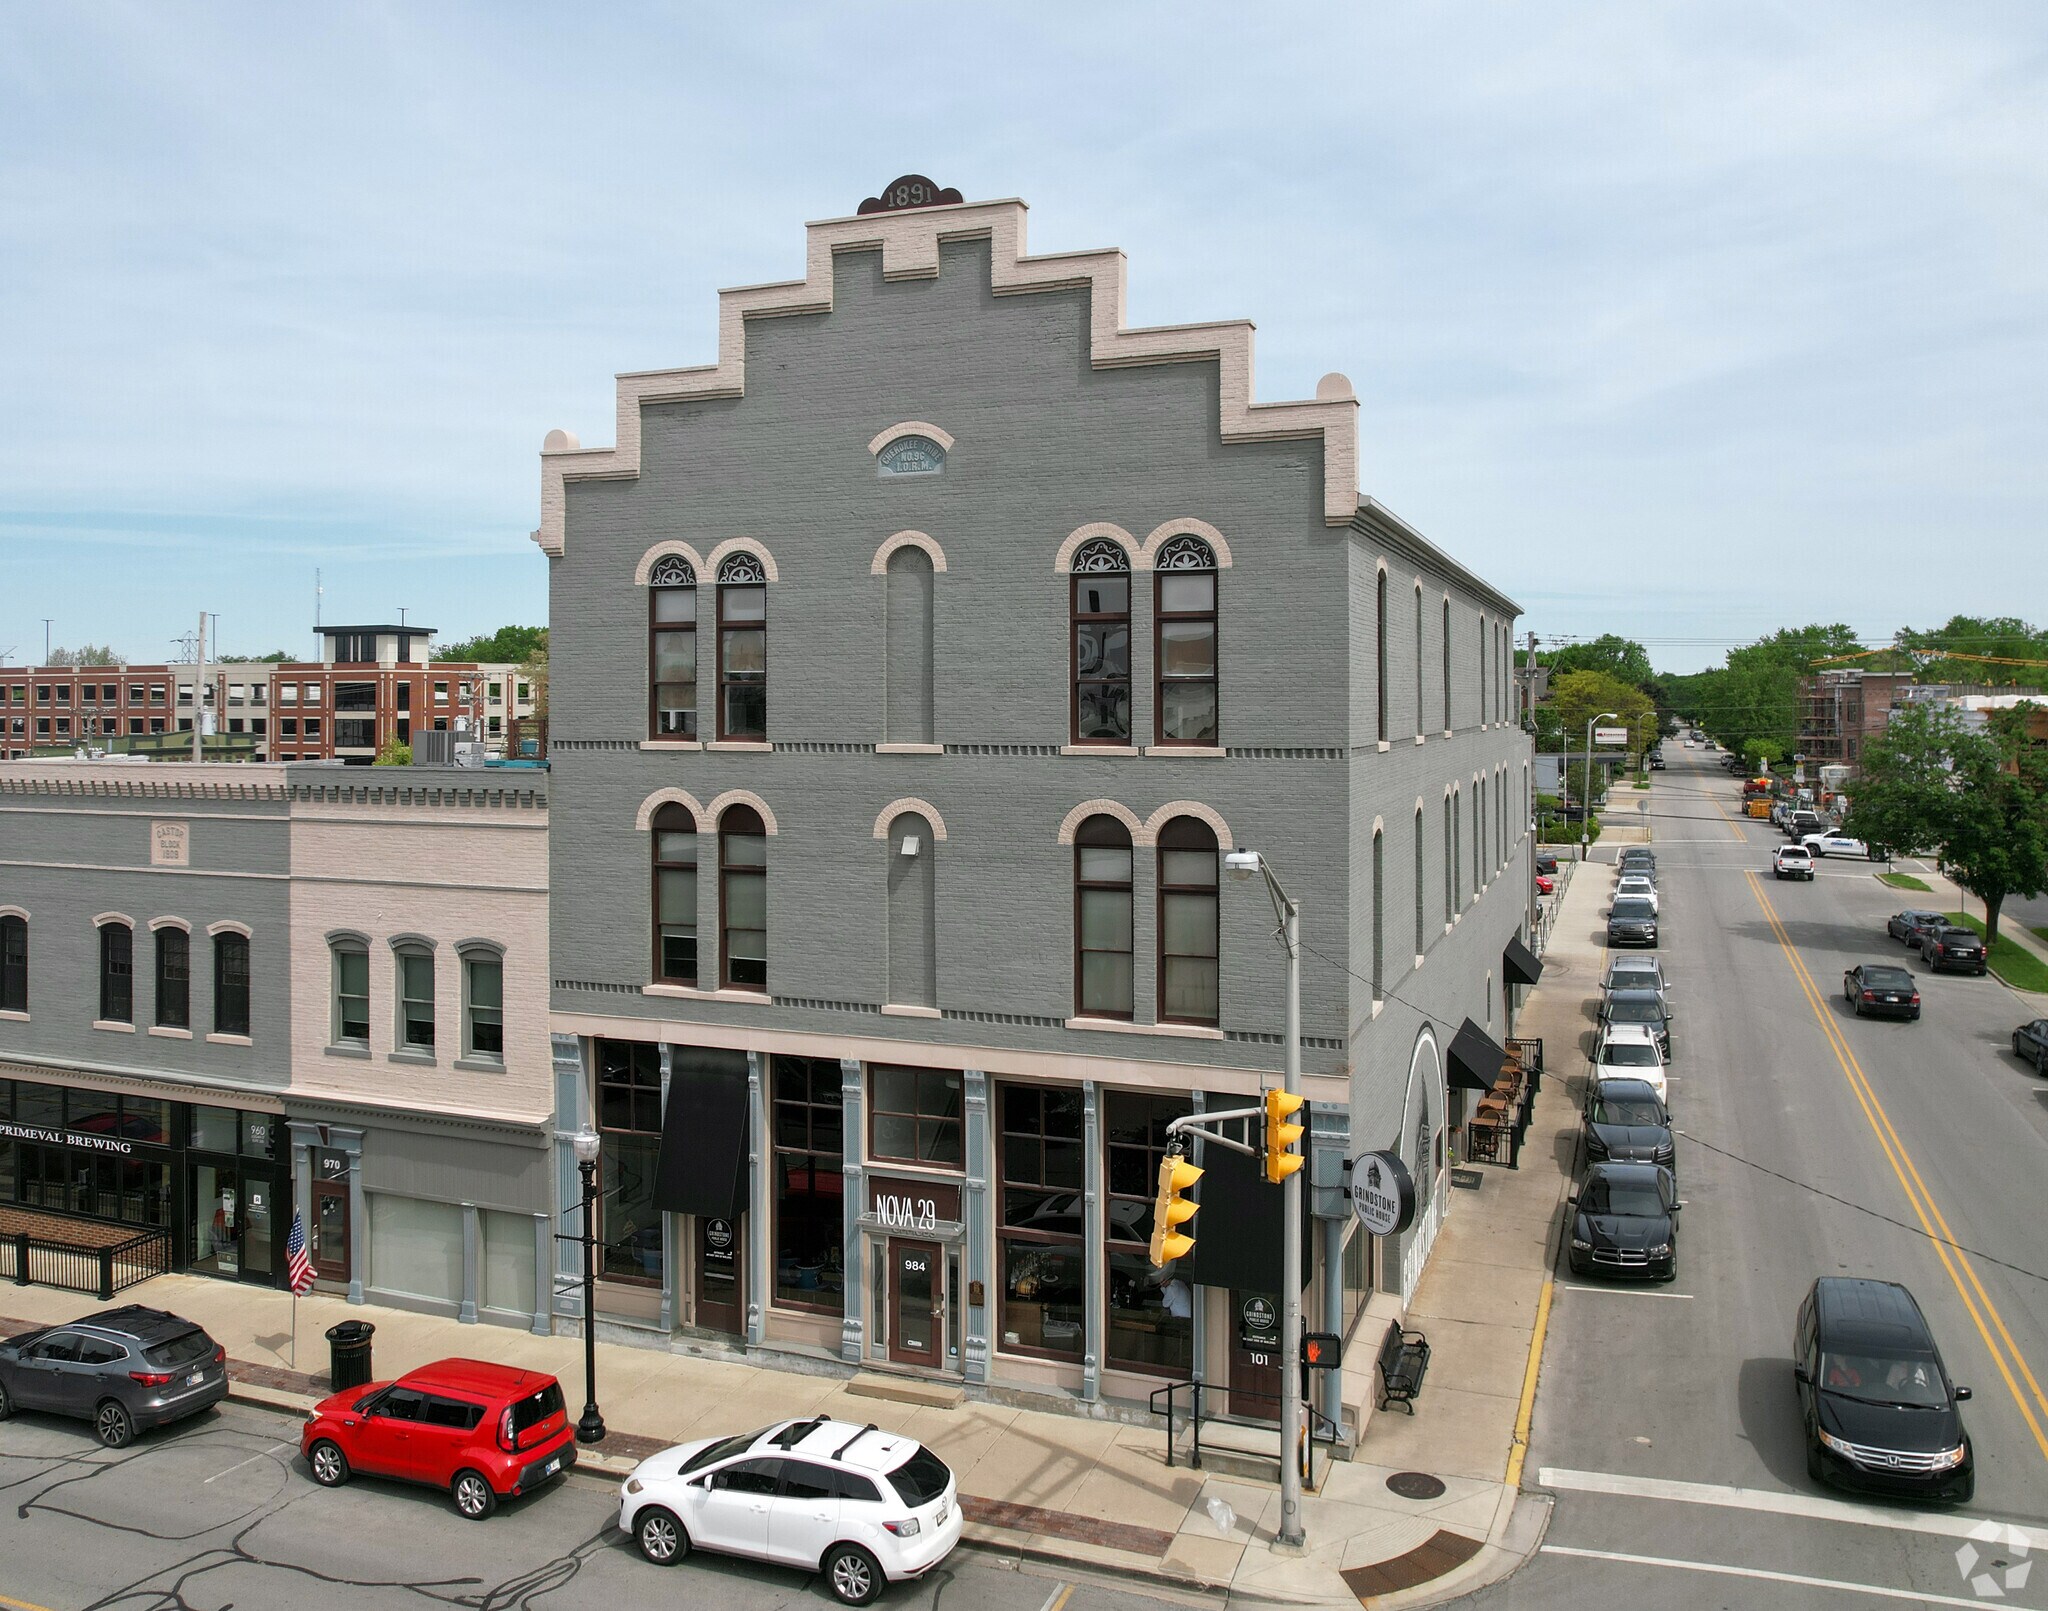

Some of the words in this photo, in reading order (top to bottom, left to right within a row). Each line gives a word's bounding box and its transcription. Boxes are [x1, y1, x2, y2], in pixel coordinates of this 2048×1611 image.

[888, 183, 933, 208] 1891
[881, 440, 919, 465] CHEROKEE
[921, 442, 944, 461] TRIBE
[160, 839, 181, 849] BLOCK
[0, 1124, 63, 1144] PRIMEVAL
[66, 1134, 132, 1154] BREWING
[250, 1125, 266, 1136] 960
[323, 1158, 341, 1170] 970
[1354, 1184, 1396, 1214] GRINDSTONE
[876, 1193, 915, 1229] NOVA
[917, 1198, 936, 1231] 29
[1358, 1202, 1375, 1217] PUBLIC
[1375, 1210, 1391, 1224] HOUSE
[904, 1260, 926, 1272] 984
[1246, 1310, 1272, 1320] GRINDSTONE
[1250, 1352, 1268, 1366] 101
